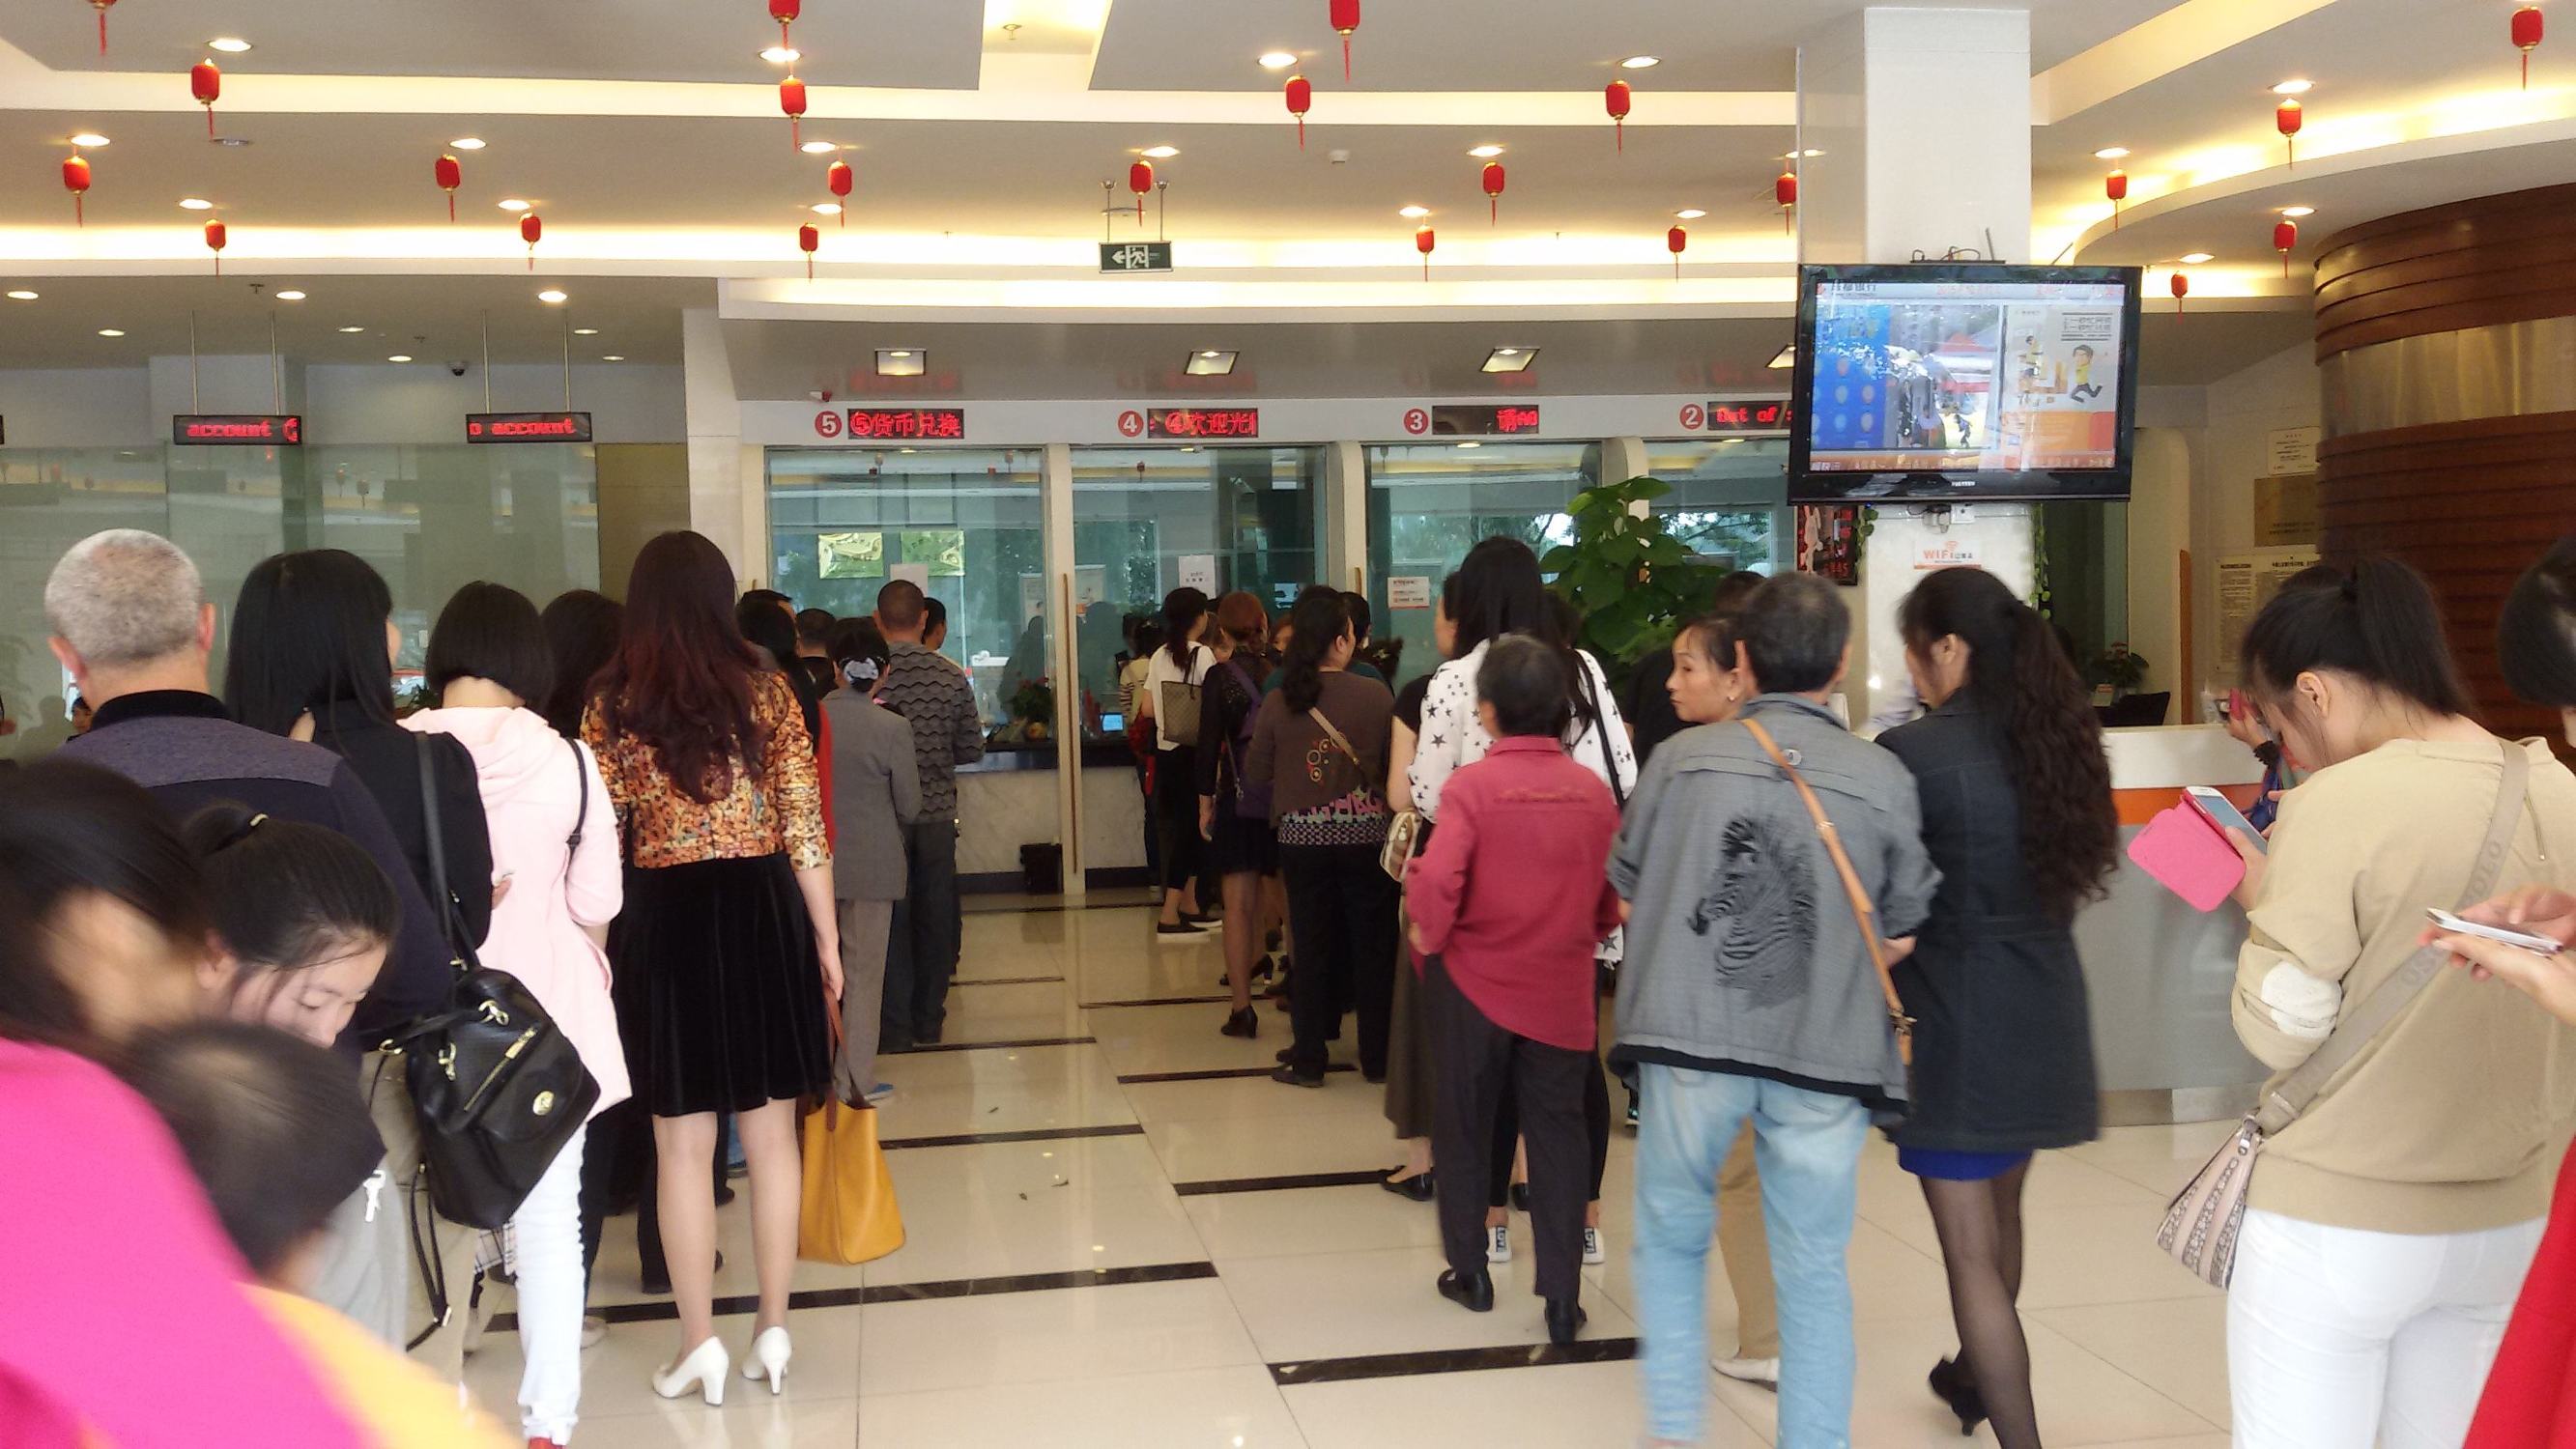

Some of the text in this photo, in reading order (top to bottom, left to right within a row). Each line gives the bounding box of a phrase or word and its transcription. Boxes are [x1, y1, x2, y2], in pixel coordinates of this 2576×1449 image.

[822, 414, 836, 434] 5
[1123, 413, 1138, 433] 4
[1410, 412, 1424, 431] 3
[1685, 407, 1699, 425] 2
[1716, 407, 1748, 423] Out
[1757, 406, 1777, 423] of
[186, 419, 272, 438] account
[490, 417, 576, 436] account
